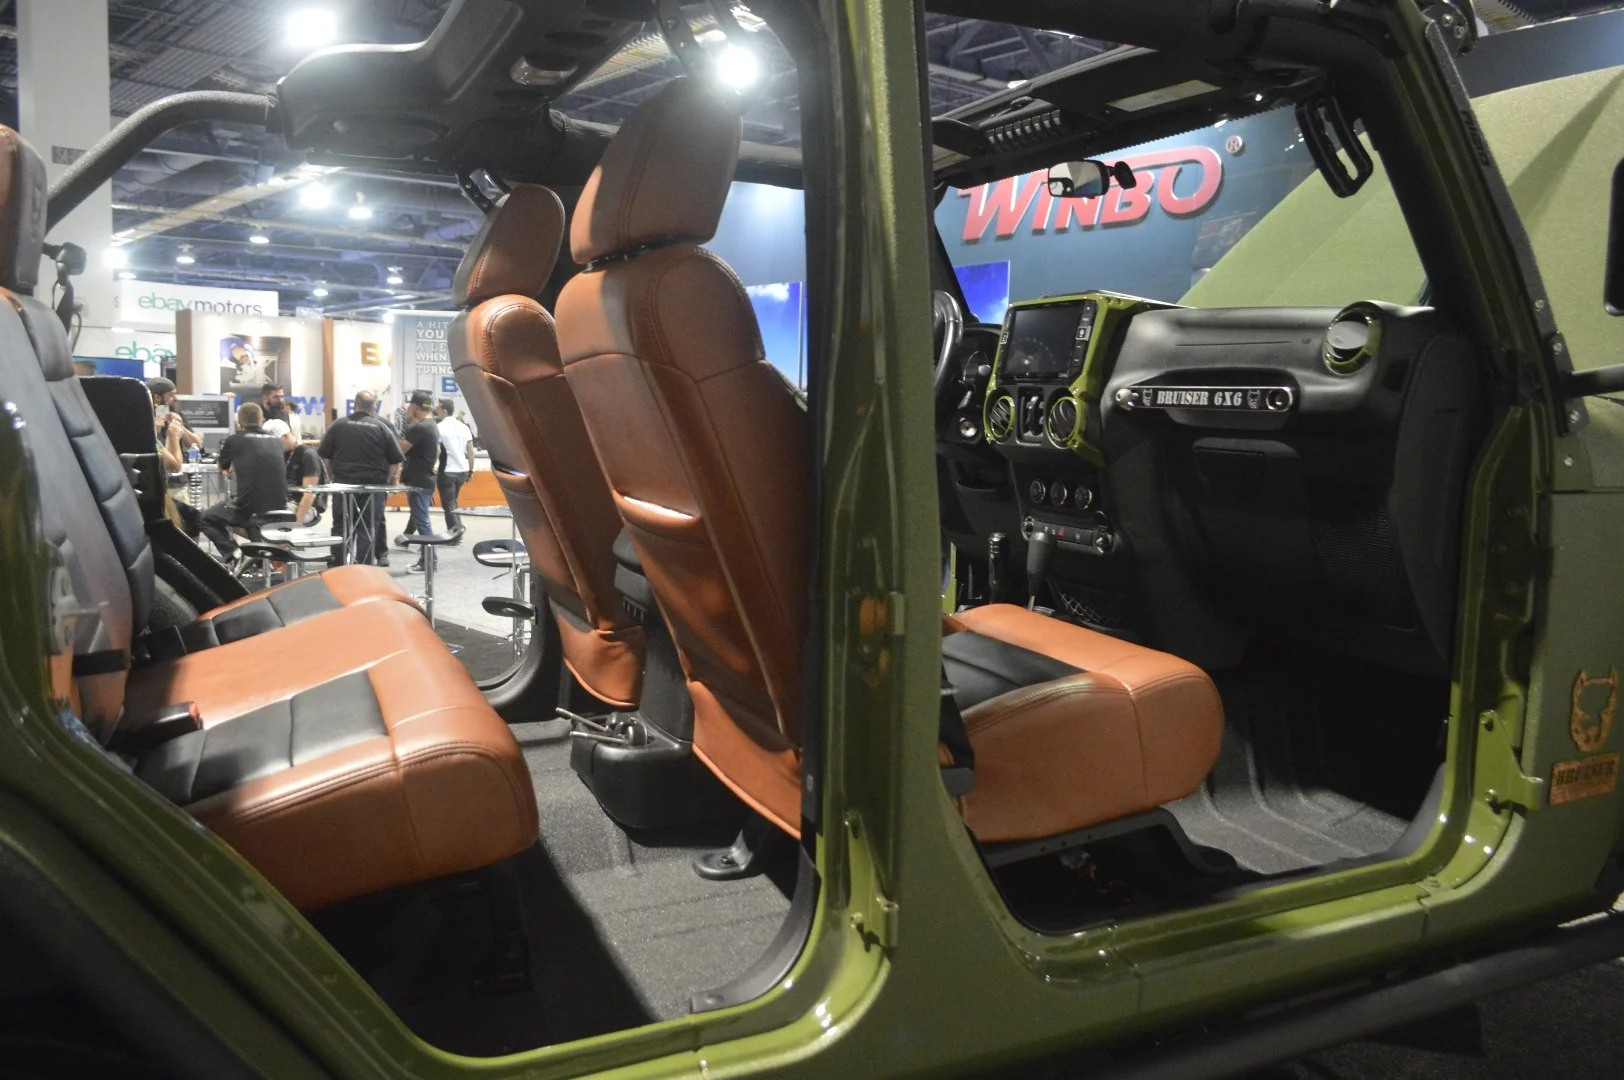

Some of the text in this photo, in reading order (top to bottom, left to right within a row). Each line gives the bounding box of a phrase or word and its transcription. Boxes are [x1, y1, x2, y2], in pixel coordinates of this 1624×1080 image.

[957, 145, 1222, 241] WINBO
[138, 292, 193, 311] ebay
[195, 299, 262, 315] motors
[416, 320, 424, 329] A
[416, 329, 444, 339] YOU
[416, 342, 424, 351] A
[416, 352, 447, 361] WHEN
[1156, 391, 1243, 406] BRUISER 6X6
